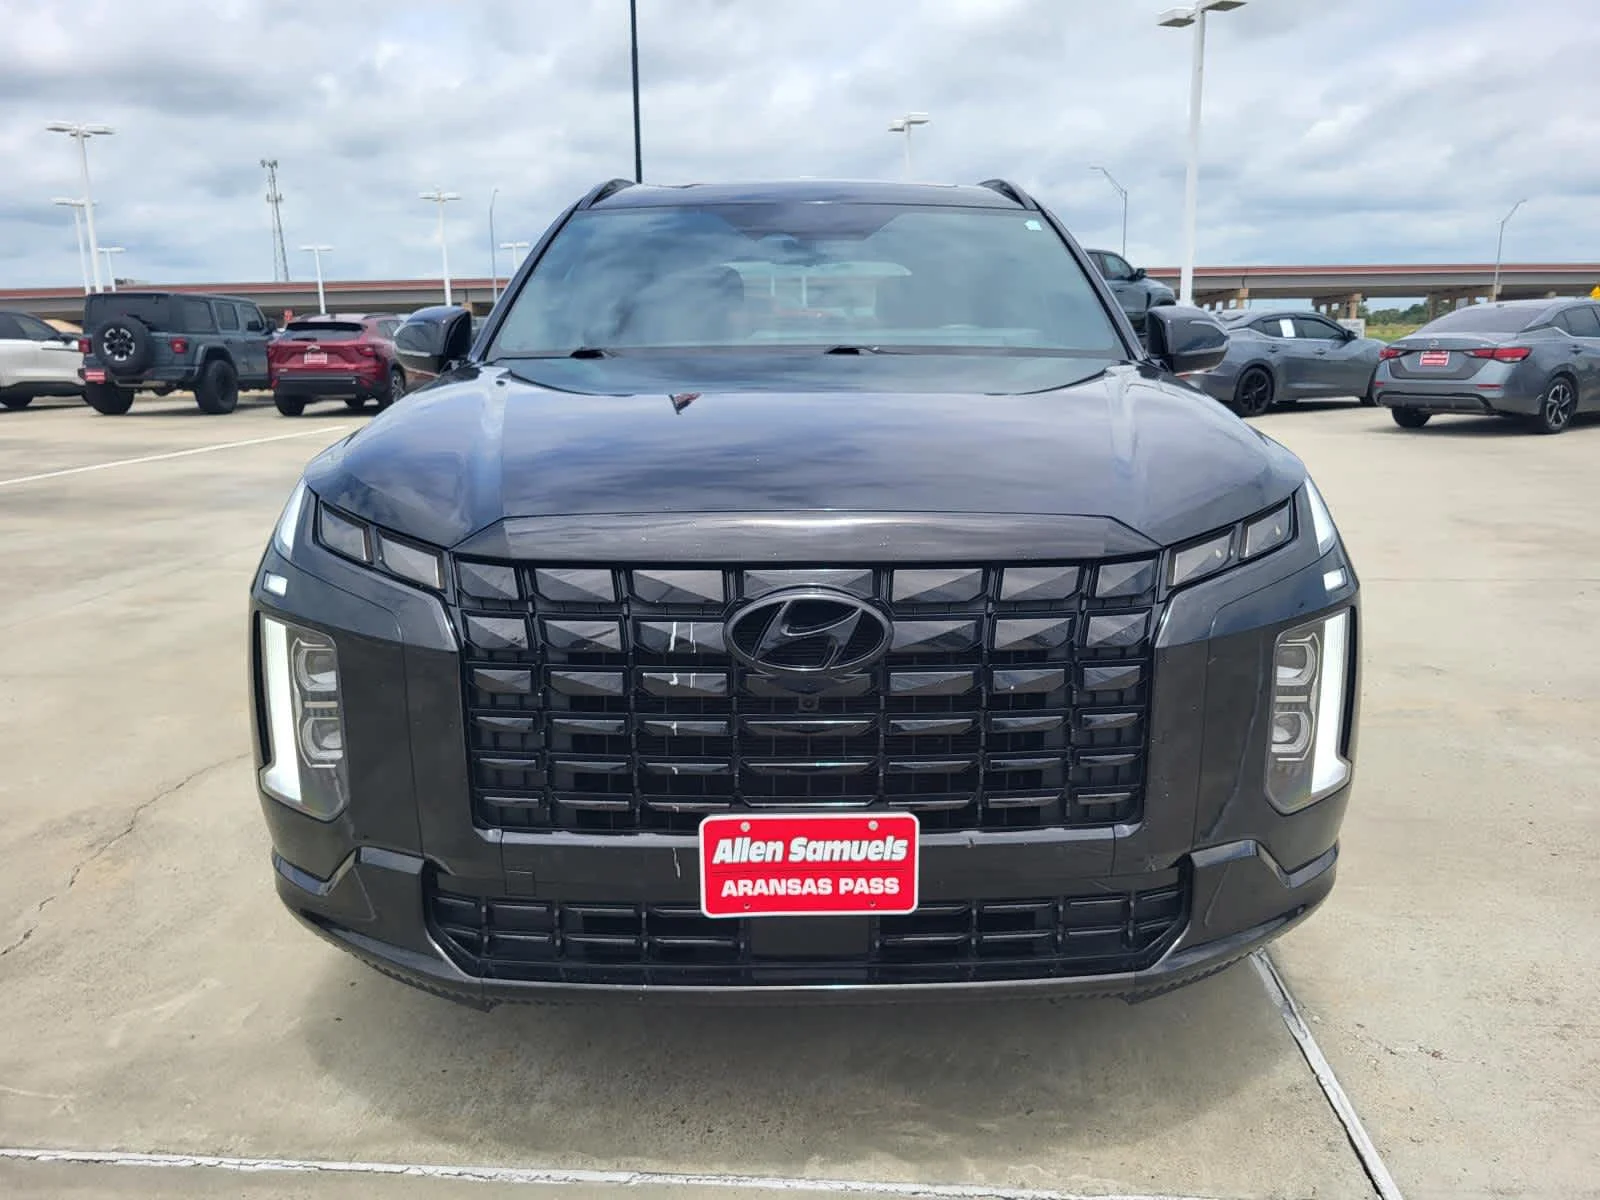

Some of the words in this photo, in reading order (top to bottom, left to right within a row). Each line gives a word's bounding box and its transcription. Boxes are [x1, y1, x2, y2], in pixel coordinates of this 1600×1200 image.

[712, 837, 784, 864] Allen
[788, 835, 909, 862] Samuels
[721, 879, 833, 897] ARANSAS
[839, 877, 900, 895] PASS
